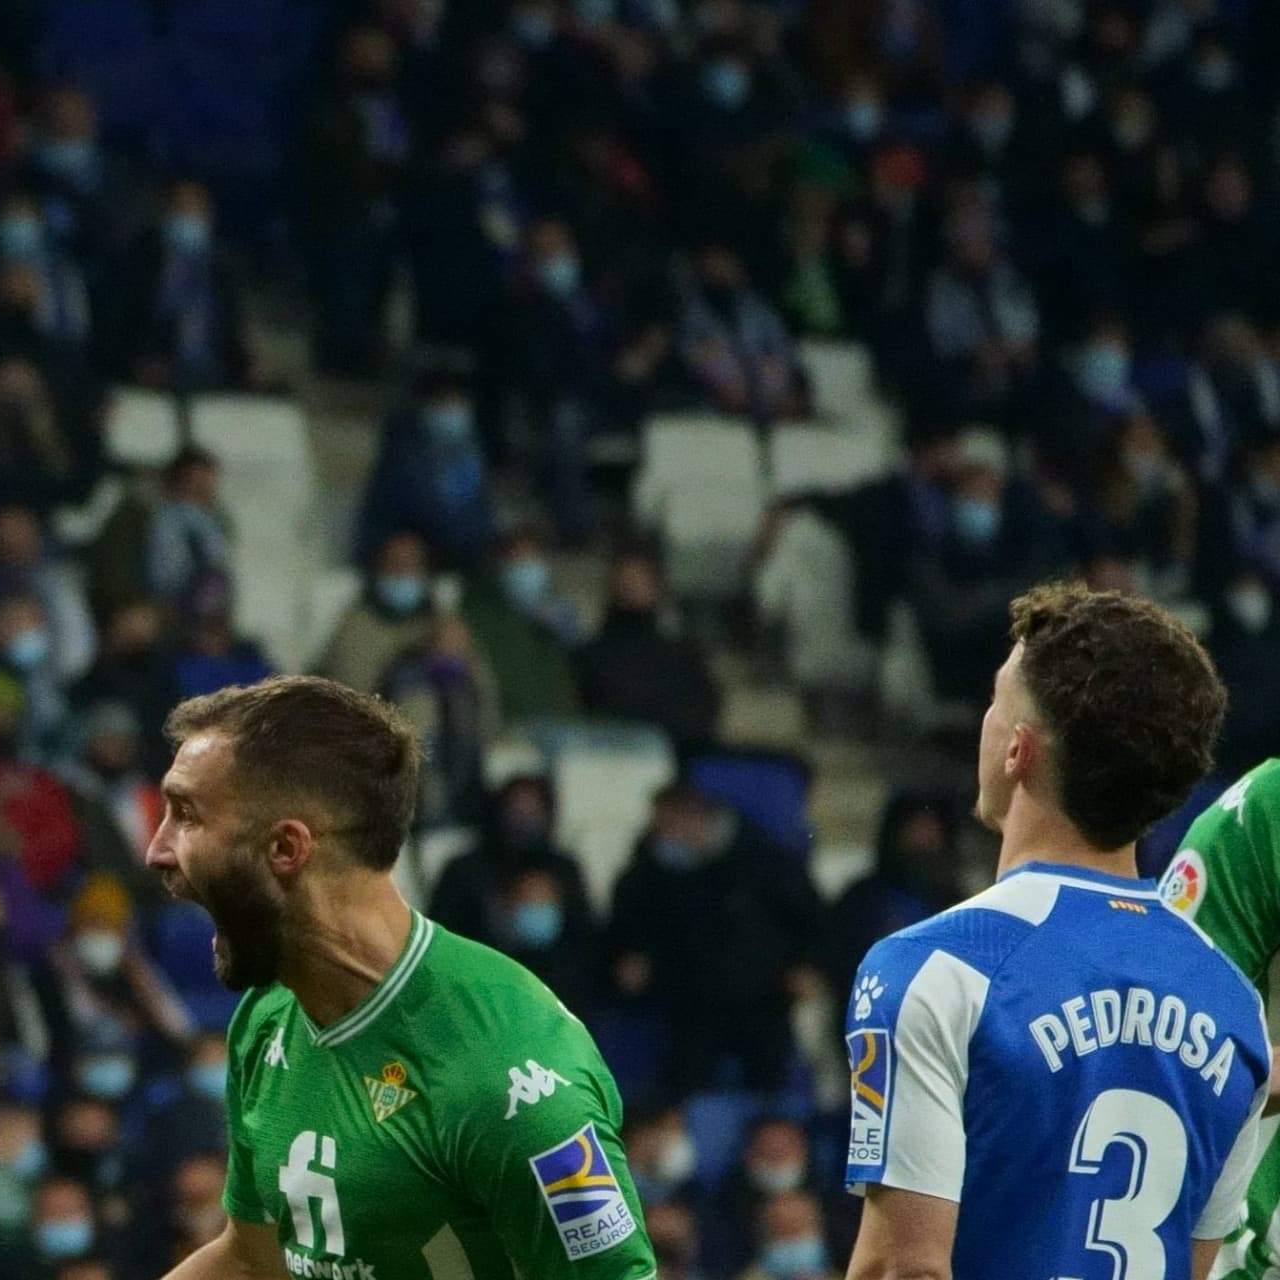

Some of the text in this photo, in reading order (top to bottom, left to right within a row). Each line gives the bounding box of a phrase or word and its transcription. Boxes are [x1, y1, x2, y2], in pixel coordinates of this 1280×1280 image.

[1028, 987, 1237, 1097] PEDROSA
[563, 1202, 628, 1244] REALE
[569, 1218, 634, 1257] SEGUROS
